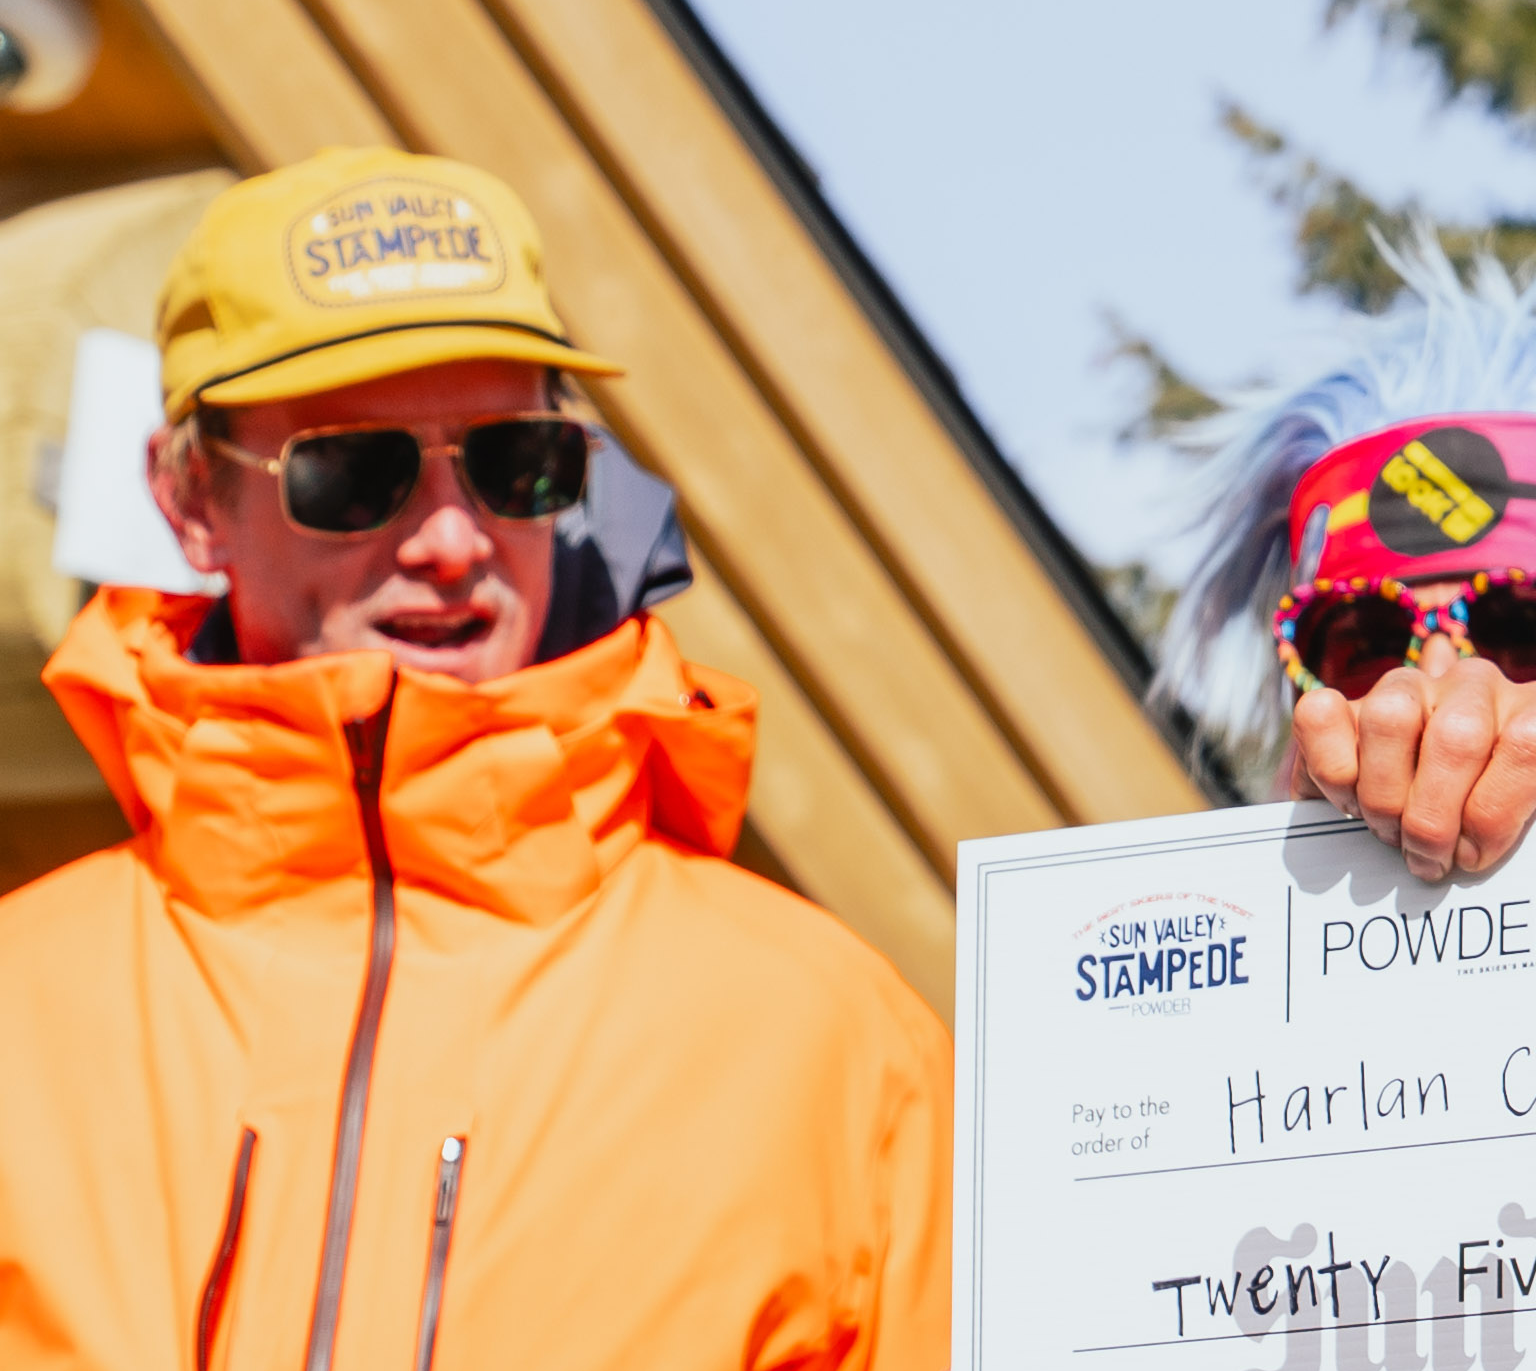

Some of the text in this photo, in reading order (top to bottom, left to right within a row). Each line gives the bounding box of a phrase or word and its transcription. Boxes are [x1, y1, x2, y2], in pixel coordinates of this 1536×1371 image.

[305, 225, 491, 276] STAMPEDE
[1109, 912, 1217, 949] SUN VALLEY
[1075, 935, 1250, 1002] STAMPEDE
[1131, 997, 1191, 1017] POWDER
[1072, 1095, 1170, 1124] Pay to the
[1227, 1061, 1449, 1154] Harlan
[1071, 1127, 1150, 1157] order of
